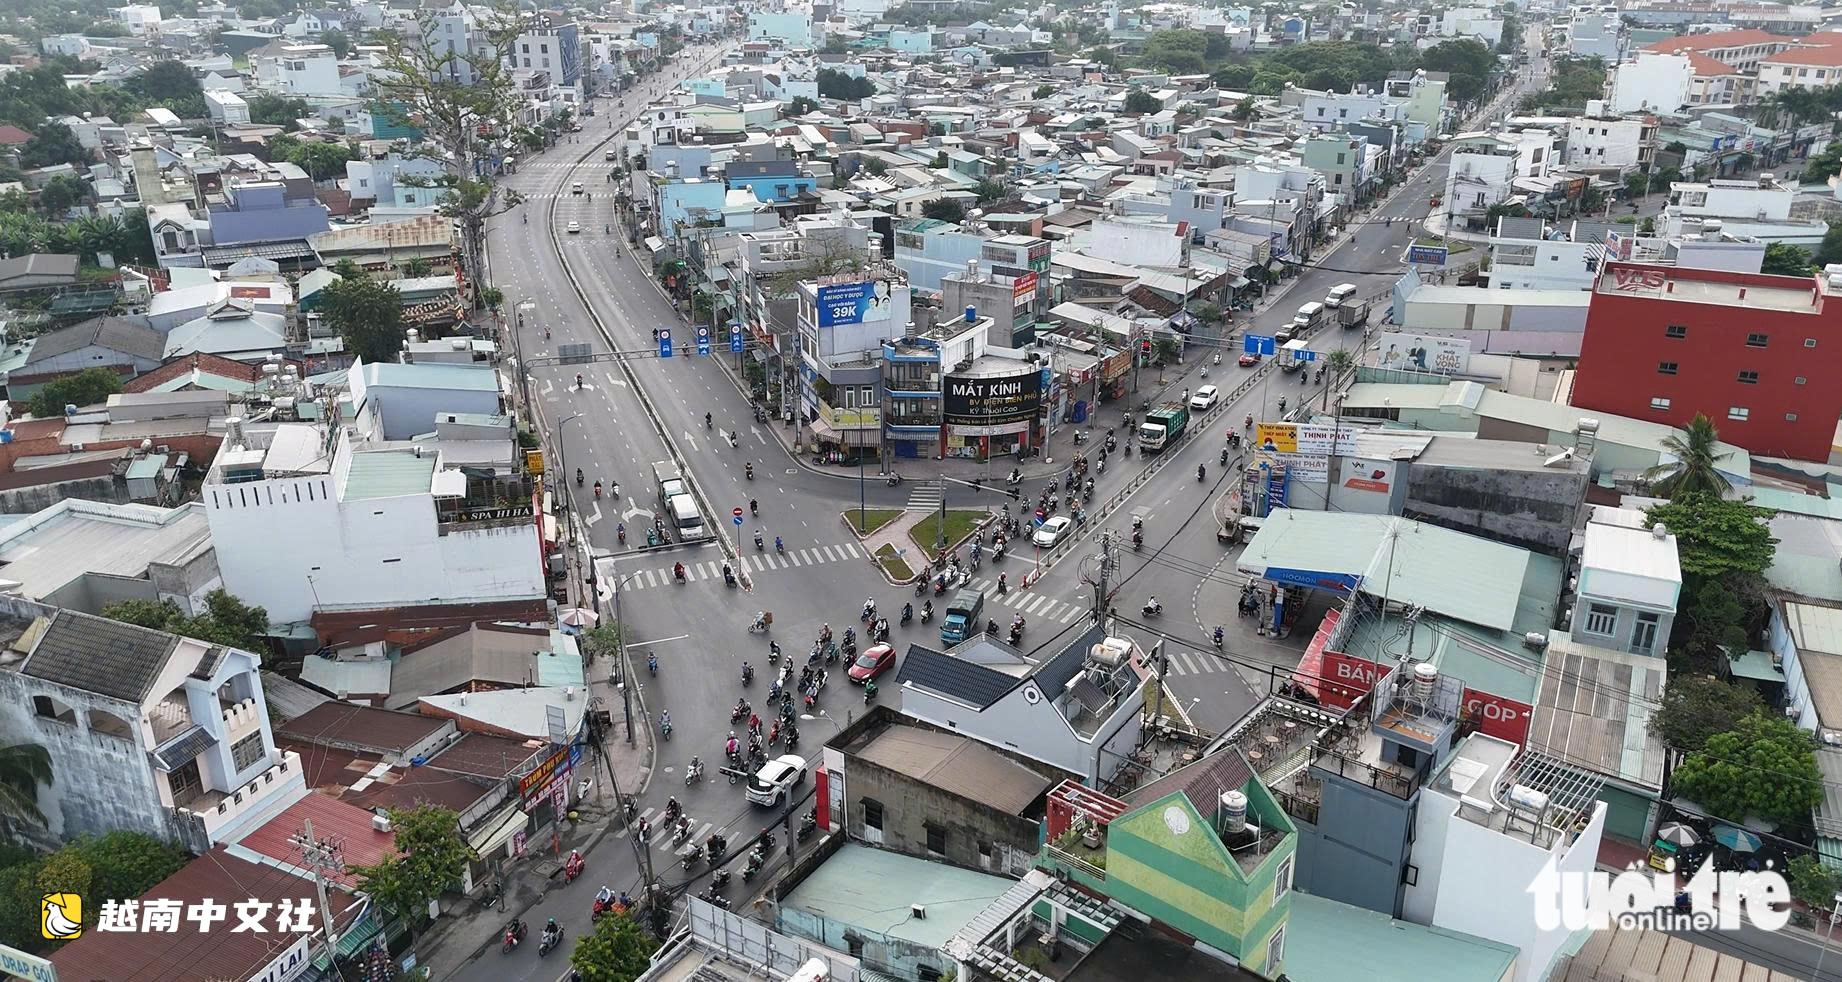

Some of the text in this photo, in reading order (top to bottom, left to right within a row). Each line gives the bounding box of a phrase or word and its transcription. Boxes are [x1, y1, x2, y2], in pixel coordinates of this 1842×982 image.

[833, 306, 856, 318] 39K
[952, 379, 1021, 396] MẮT KÍNH
[1304, 432, 1327, 440] THỊNH
[470, 511, 492, 520] SPA
[1337, 659, 1517, 722] BÁN GÓP
[1, 953, 29, 976] DRAP
[280, 948, 302, 973] LAI
